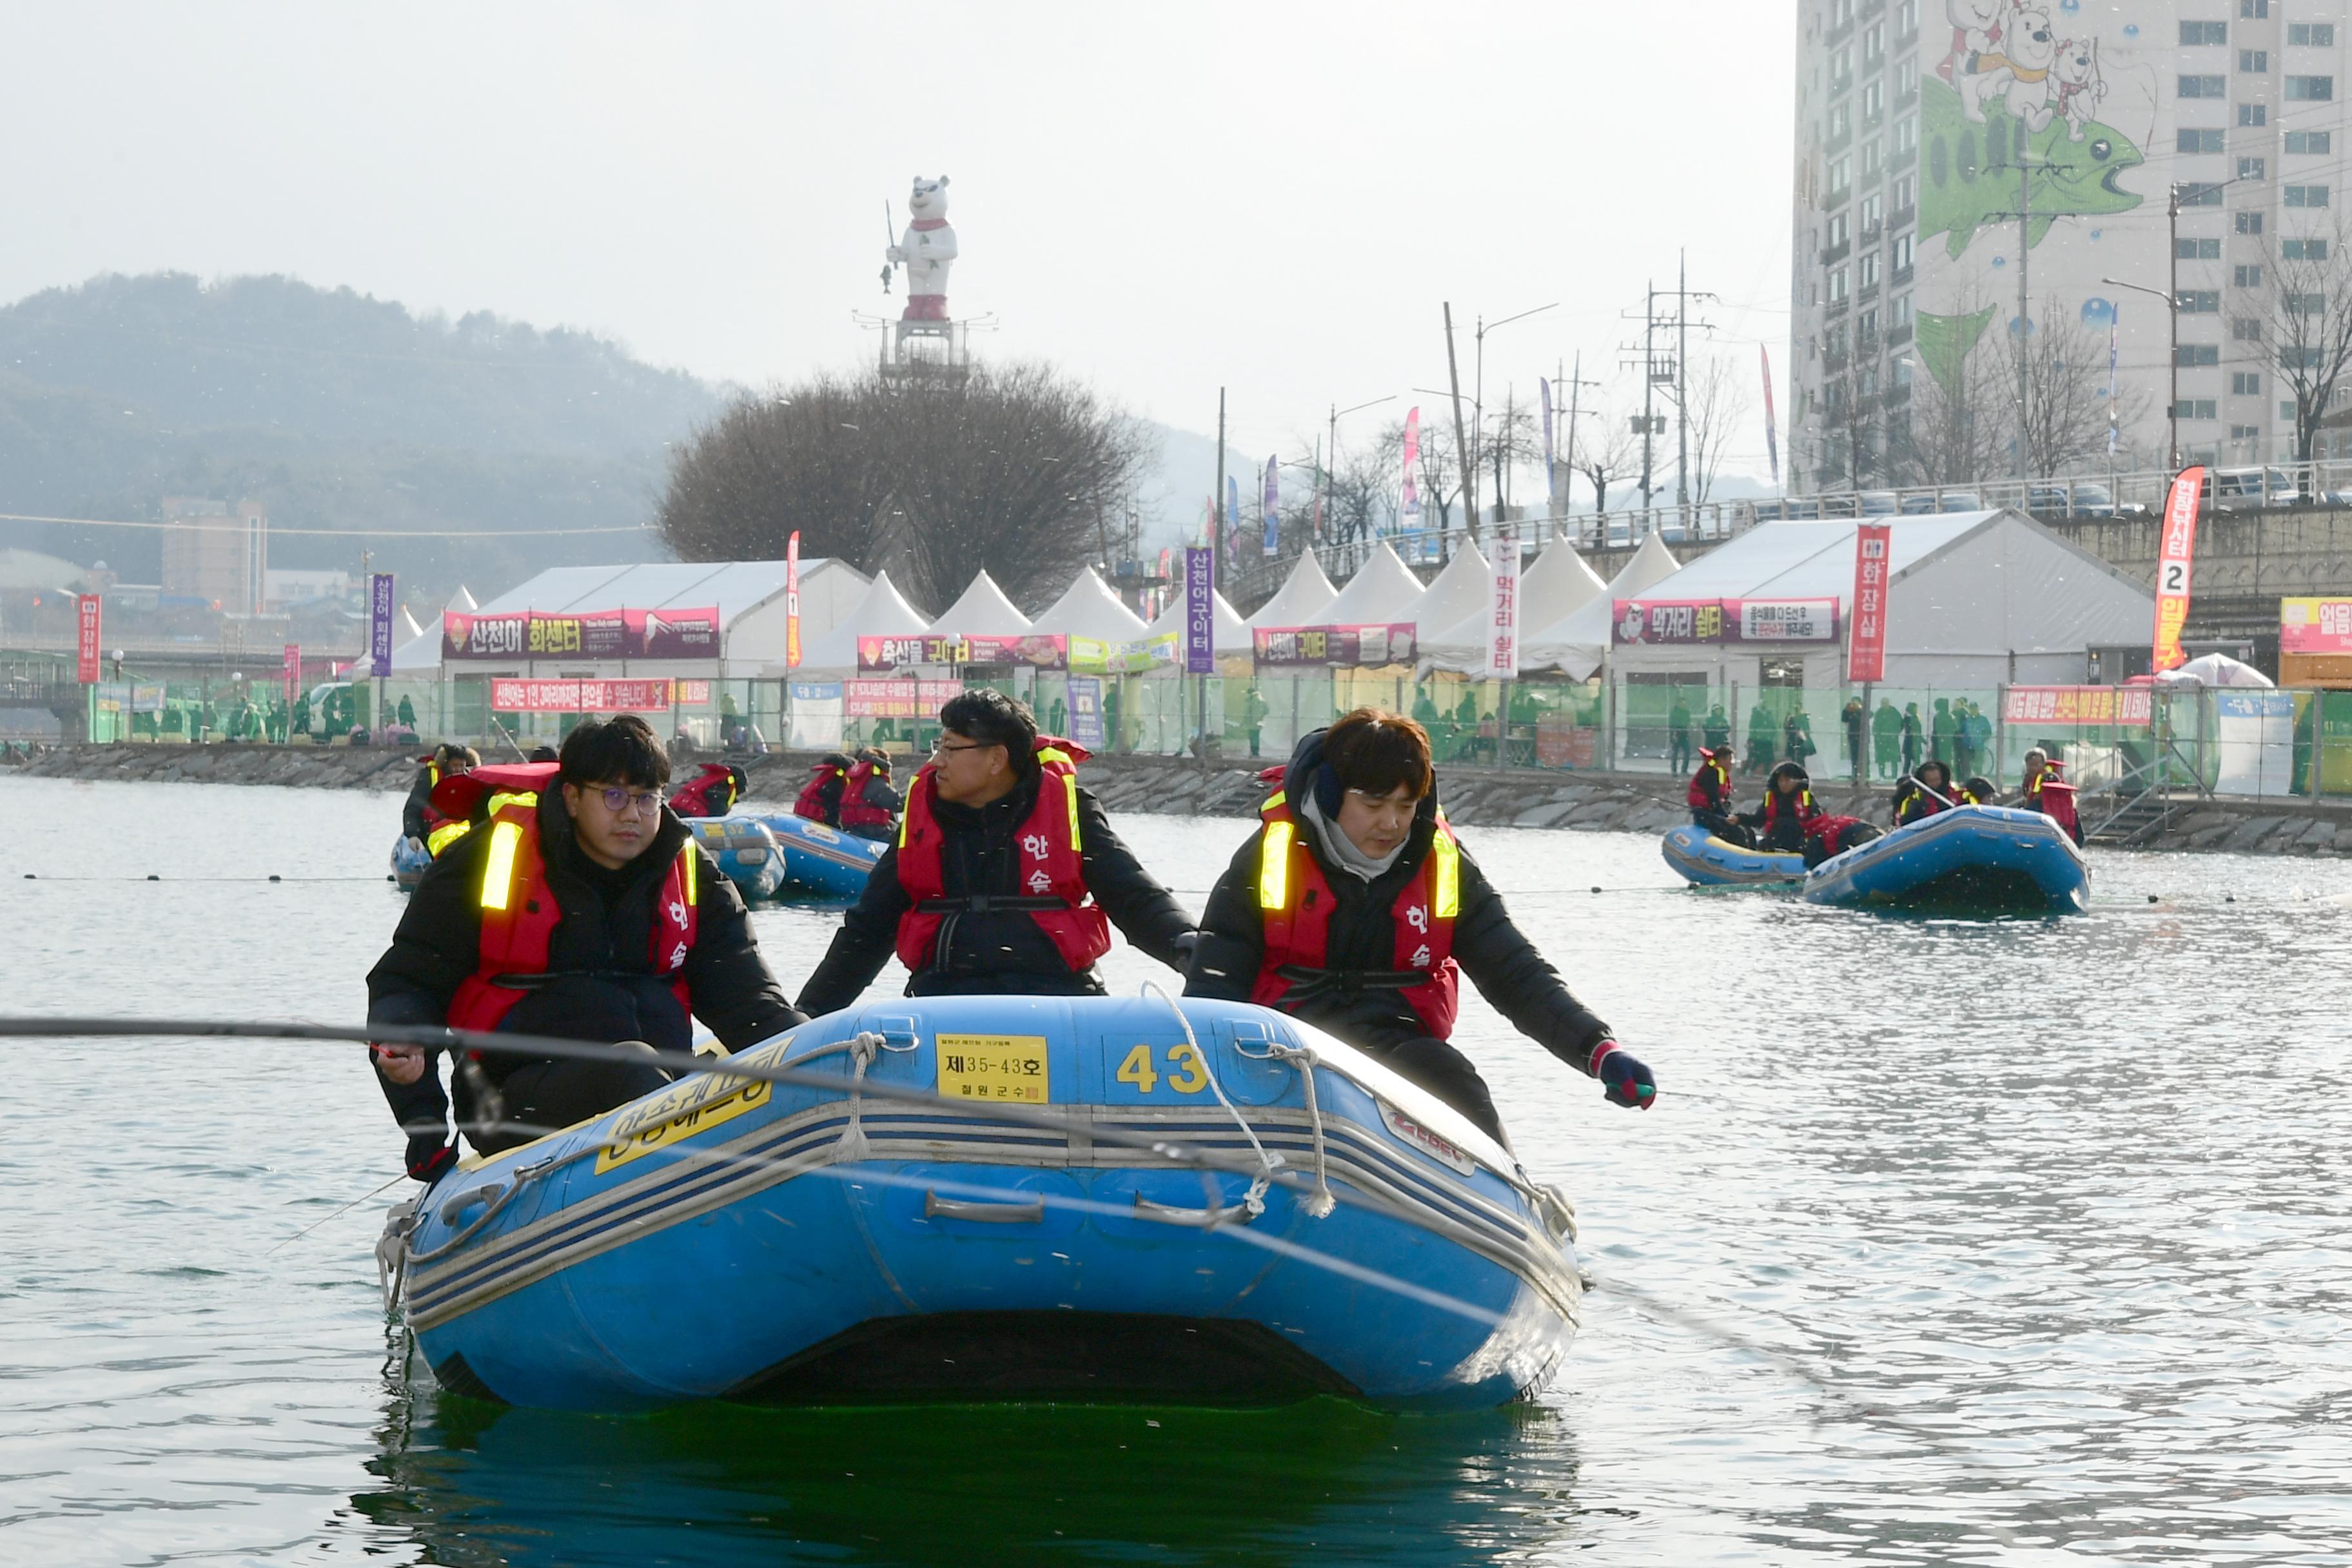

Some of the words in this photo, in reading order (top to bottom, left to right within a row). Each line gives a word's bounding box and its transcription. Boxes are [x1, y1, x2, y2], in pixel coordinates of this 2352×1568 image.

[2168, 480, 2195, 558] 현장낚시터
[2166, 565, 2182, 590] 2
[377, 580, 389, 617] 산천어
[1192, 552, 1209, 652] 산천어구이터
[1495, 576, 1513, 627] 먹거리
[1861, 562, 1882, 638] 화장실
[84, 614, 95, 659] 화장실
[471, 619, 522, 653] 산천어
[527, 618, 580, 652] 회센터
[1652, 606, 1692, 637] 먹거리
[1695, 605, 1721, 637] 쉼터
[2319, 603, 2352, 635] 얼음
[376, 621, 388, 658] 회센터
[882, 640, 923, 664] 축산물
[497, 681, 525, 707] 산천어는
[527, 682, 538, 707] 1인
[946, 1055, 1041, 1076] 제35-43호
[1117, 1044, 1209, 1093] 43
